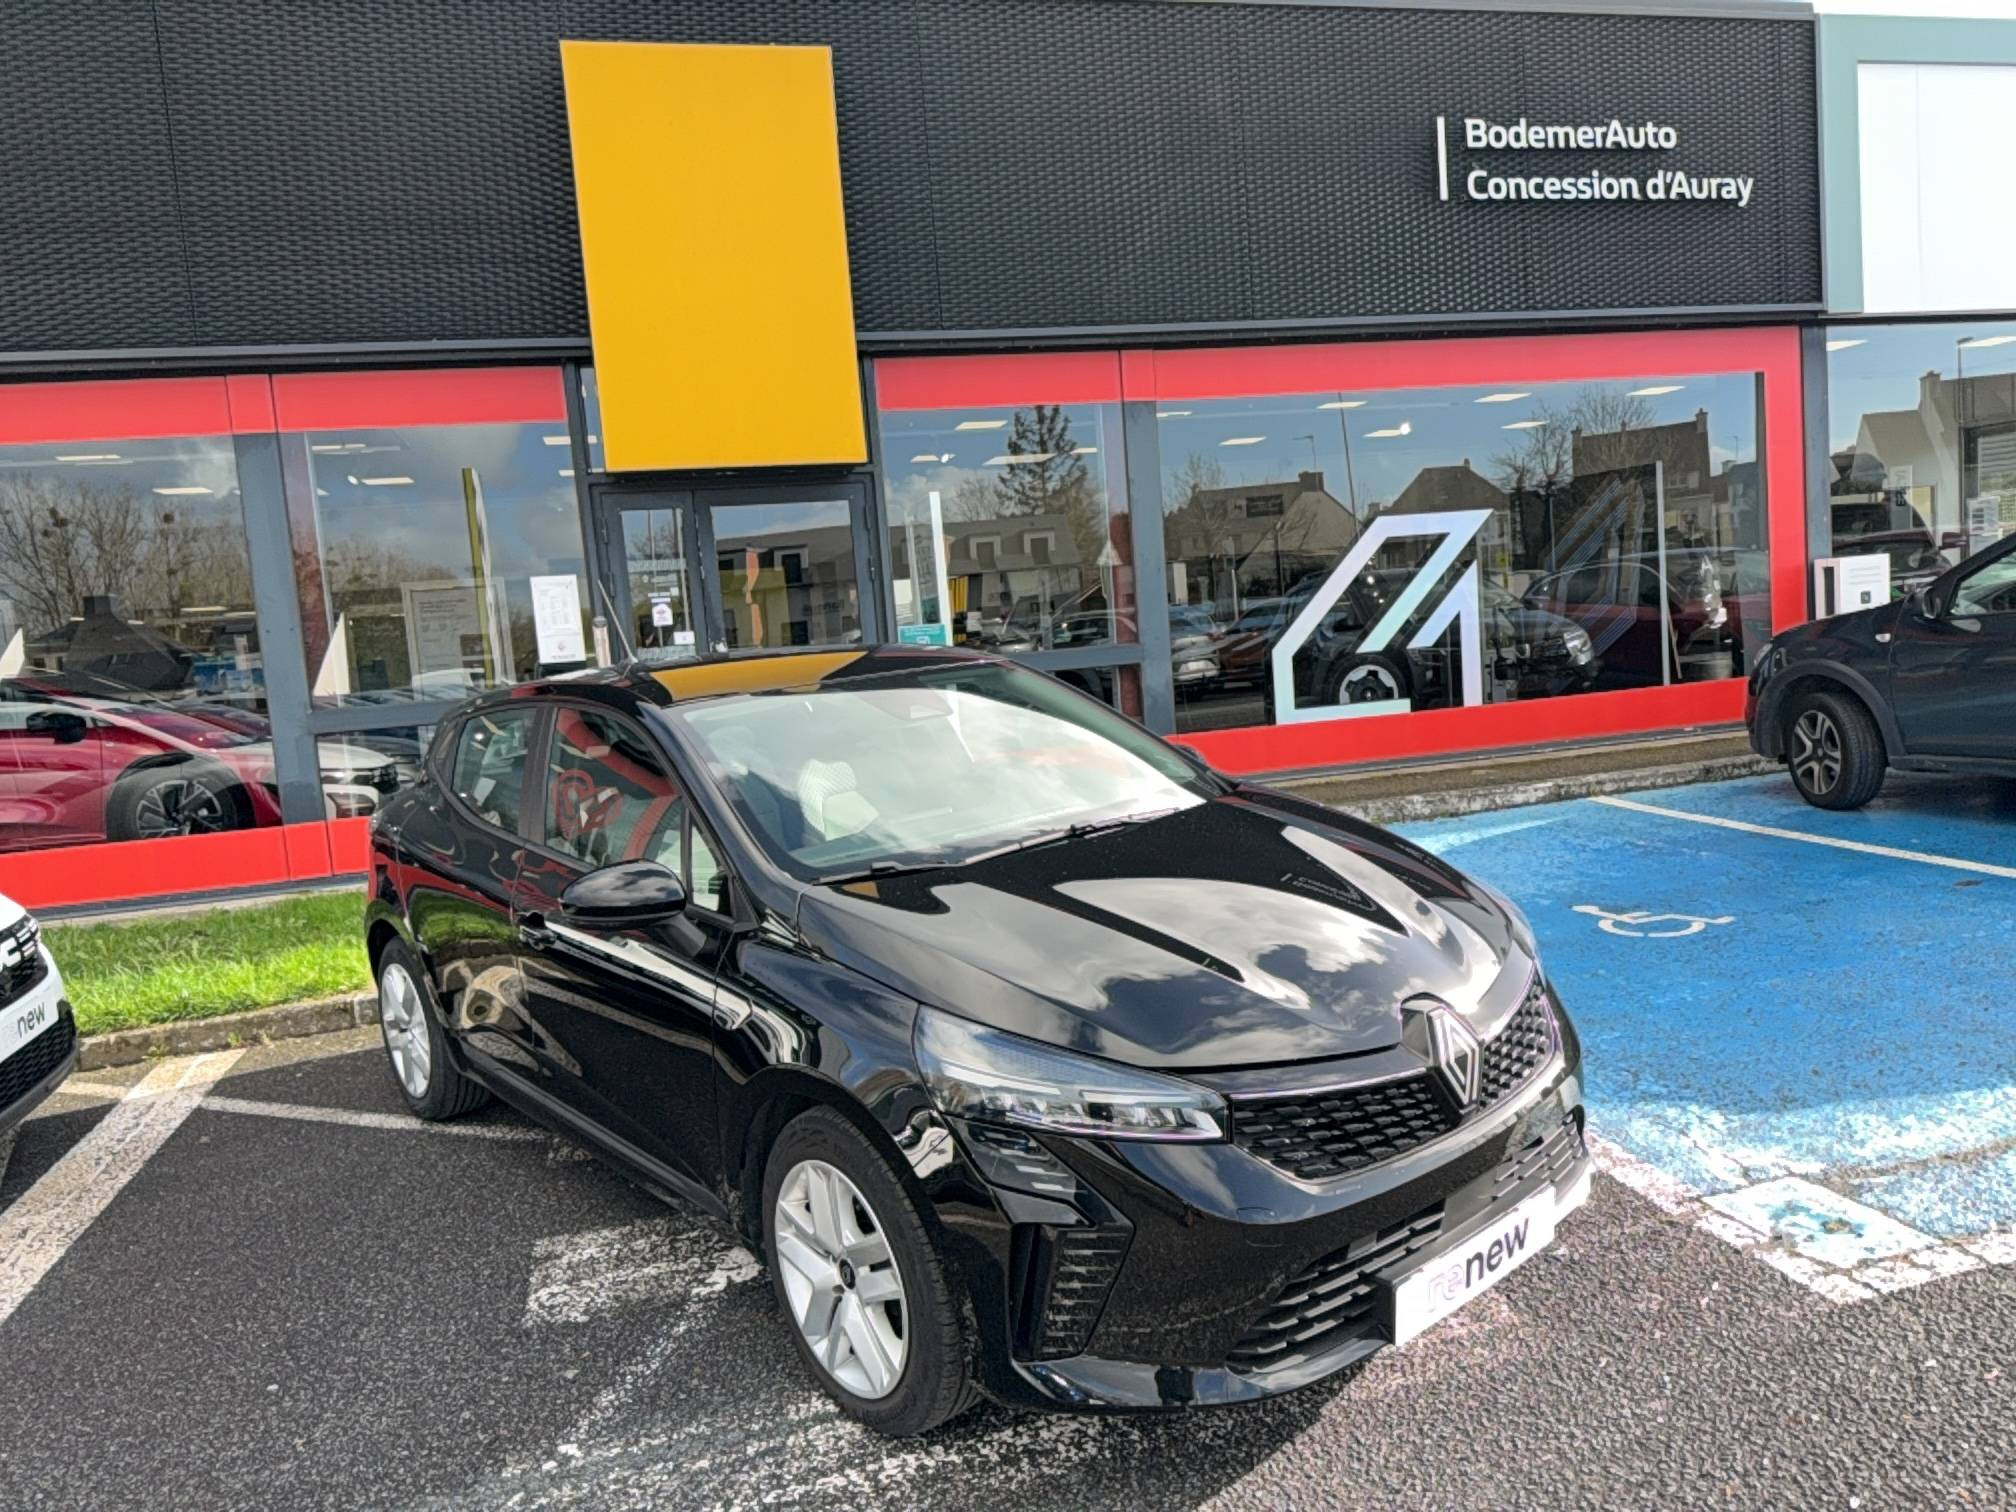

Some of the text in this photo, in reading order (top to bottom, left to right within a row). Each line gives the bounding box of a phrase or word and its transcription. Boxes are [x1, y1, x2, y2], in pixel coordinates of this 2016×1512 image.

[1464, 117, 1677, 149] BodemerAuto
[1467, 169, 1754, 207] Concession d'Auray
